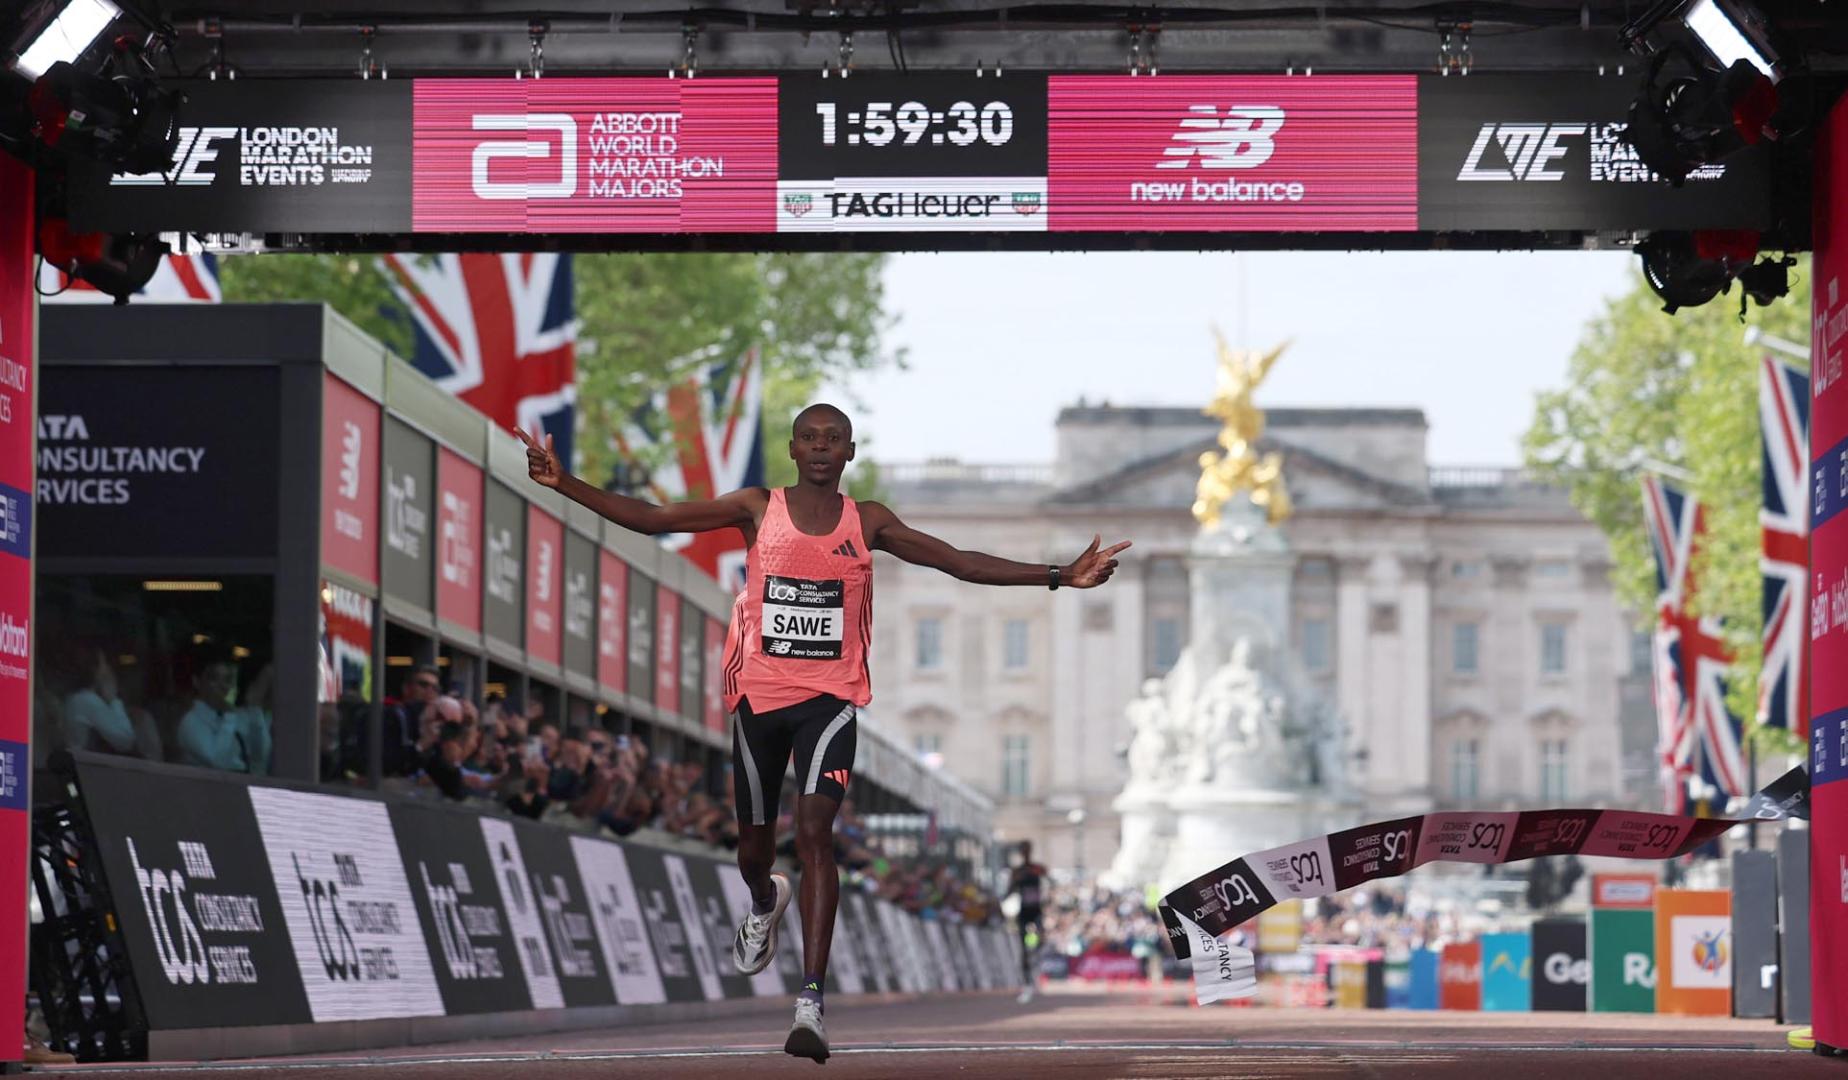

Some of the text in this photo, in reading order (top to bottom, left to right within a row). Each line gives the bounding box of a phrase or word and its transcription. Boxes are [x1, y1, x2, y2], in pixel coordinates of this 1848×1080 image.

[589, 113, 683, 134] ABBOTT
[815, 101, 1013, 146] 1:59:30
[240, 127, 338, 146] LONDON
[588, 135, 677, 156] WORLD
[240, 146, 372, 165] MARATHON
[589, 156, 724, 178] MARATHON
[240, 165, 325, 186] EVENTS
[589, 178, 684, 198] MAJORS
[1130, 177, 1305, 201] new balance
[37, 446, 205, 473] NSULTANCY
[768, 580, 796, 602] tcs
[773, 613, 832, 637] SAWE
[806, 649, 834, 657] balance
[1468, 822, 1506, 856] tcs
[1290, 851, 1325, 887] tcs
[1213, 873, 1260, 912] tcs
[125, 836, 210, 985] tcs
[290, 851, 361, 982] tcs
[1623, 952, 1657, 988] R
